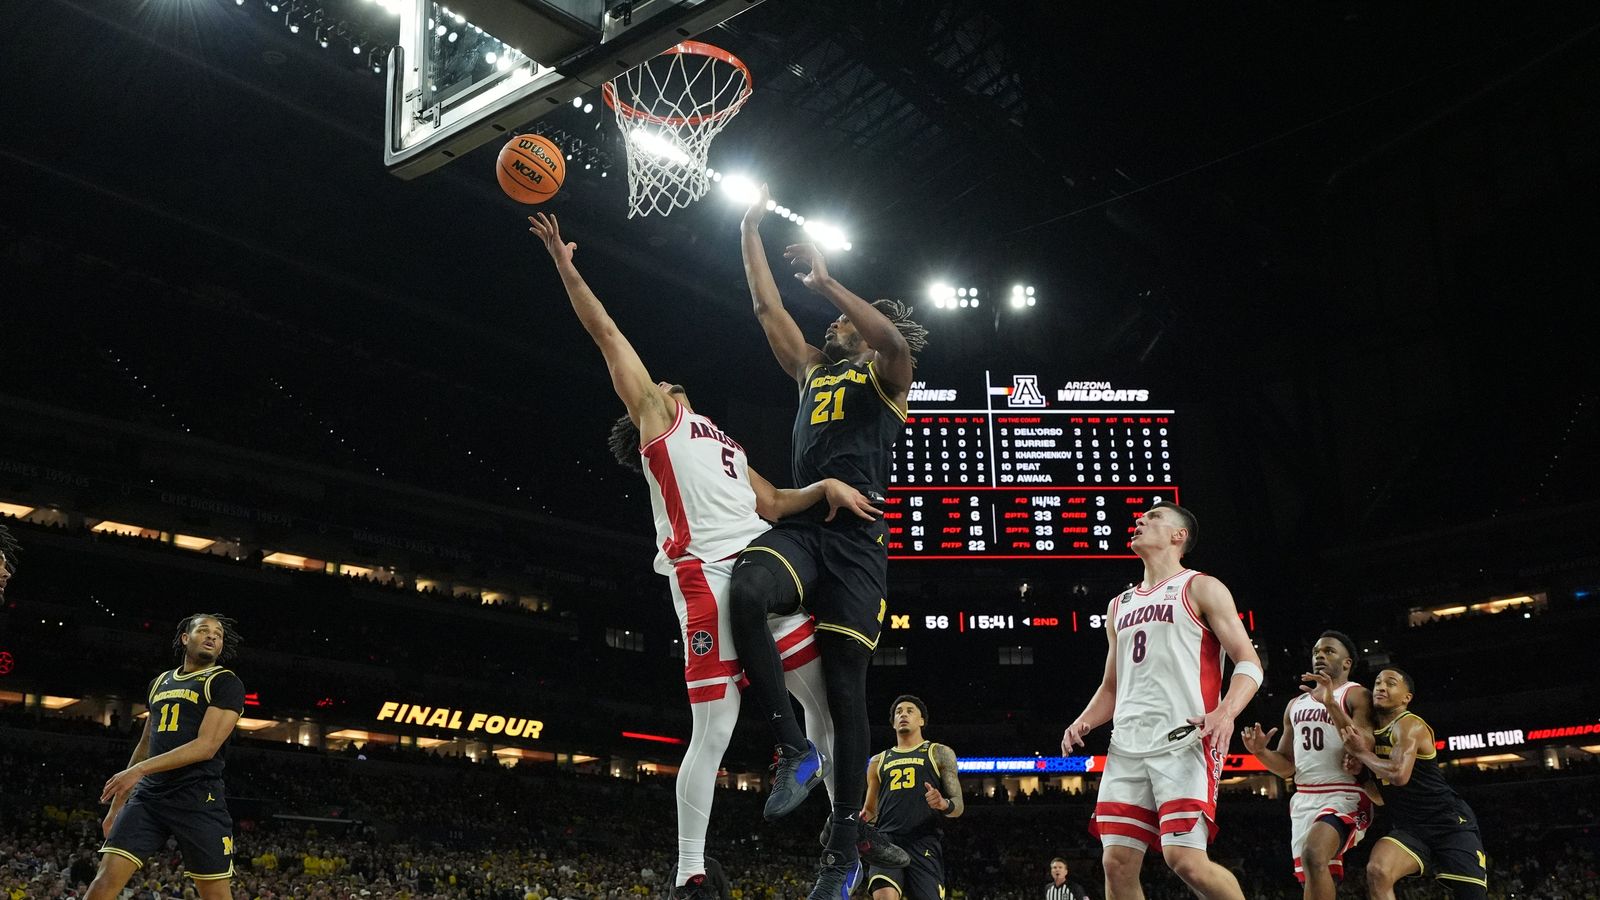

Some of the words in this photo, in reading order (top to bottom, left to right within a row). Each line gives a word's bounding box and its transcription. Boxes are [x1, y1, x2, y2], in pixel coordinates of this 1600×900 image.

[518, 139, 558, 173] Wilson
[512, 159, 544, 184] NCAA
[1007, 374, 1047, 408] A
[1064, 381, 1112, 390] ARIZONA
[906, 389, 958, 402] ERINES
[1057, 389, 1150, 402] WILDCATS
[811, 386, 846, 425] 21
[690, 421, 746, 453] ARIZON
[905, 428, 914, 436] 4
[940, 428, 948, 436] 3
[957, 428, 966, 436] 0
[1000, 428, 1008, 436] 3
[1013, 428, 1064, 436] DELL'ORSO
[1073, 428, 1082, 436] 3
[1142, 428, 1151, 436] 0
[1159, 428, 1168, 436] 0
[905, 440, 914, 448] 4
[957, 440, 967, 448] 0
[1001, 440, 1009, 448] 5
[1014, 440, 1056, 448] BURRIES
[1074, 440, 1082, 448] 2
[1125, 440, 1134, 448] 0
[1143, 440, 1152, 448] 0
[1160, 440, 1169, 448] 2
[906, 451, 914, 460] 2
[941, 451, 950, 460] 0
[958, 451, 967, 459] 0
[975, 451, 984, 460] 0
[1014, 451, 1072, 460] KHARCHENKOV
[1075, 451, 1083, 459] 5
[1092, 451, 1101, 460] 3
[1109, 451, 1118, 460] 0
[1144, 451, 1153, 460] 0
[1161, 451, 1170, 460] 0
[721, 446, 738, 480] 5
[906, 463, 915, 471] 5
[924, 463, 932, 471] 2
[941, 463, 950, 471] 0
[959, 463, 968, 471] 0
[976, 463, 985, 471] 2
[1001, 463, 1012, 471] 10
[1015, 463, 1041, 471] PEAT
[1110, 463, 1119, 471] 0
[1162, 463, 1171, 471] 0
[907, 475, 915, 483] 3
[924, 475, 934, 483] 0
[959, 475, 969, 483] 0
[977, 475, 985, 483] 2
[1000, 475, 1014, 483] 30
[1016, 475, 1053, 483] AWAKA
[1111, 475, 1120, 483] 0
[1128, 475, 1137, 483] 0
[1146, 475, 1155, 483] 0
[1163, 475, 1172, 483] 2
[909, 497, 924, 507] 15
[969, 496, 979, 507] 2
[1031, 496, 1061, 508] 14/42
[1095, 496, 1106, 507] 3
[912, 511, 922, 522] 8
[970, 511, 981, 522] 6
[1033, 511, 1052, 522] 33
[1096, 511, 1107, 521] 9
[910, 526, 925, 537] 21
[969, 526, 983, 537] 15
[1034, 526, 1053, 536] 33
[1093, 526, 1112, 536] 20
[913, 541, 924, 552] 5
[968, 541, 986, 551] 22
[1035, 540, 1055, 551] 60
[1098, 540, 1109, 551] 4
[891, 615, 910, 629] M
[925, 615, 949, 629] 56
[969, 615, 1014, 629] 15:41
[1033, 617, 1059, 627] 2ND
[1117, 604, 1174, 632] ARIZONA
[1132, 629, 1147, 664] 8
[157, 703, 180, 732] 11
[376, 701, 463, 730] FINAL
[467, 712, 544, 739] FOUR
[1301, 726, 1325, 751] 30
[1448, 733, 1486, 751] FINAL
[1487, 729, 1525, 747] FOUR
[957, 760, 995, 770] HERE
[996, 760, 1035, 770] WERE
[889, 766, 916, 791] 23
